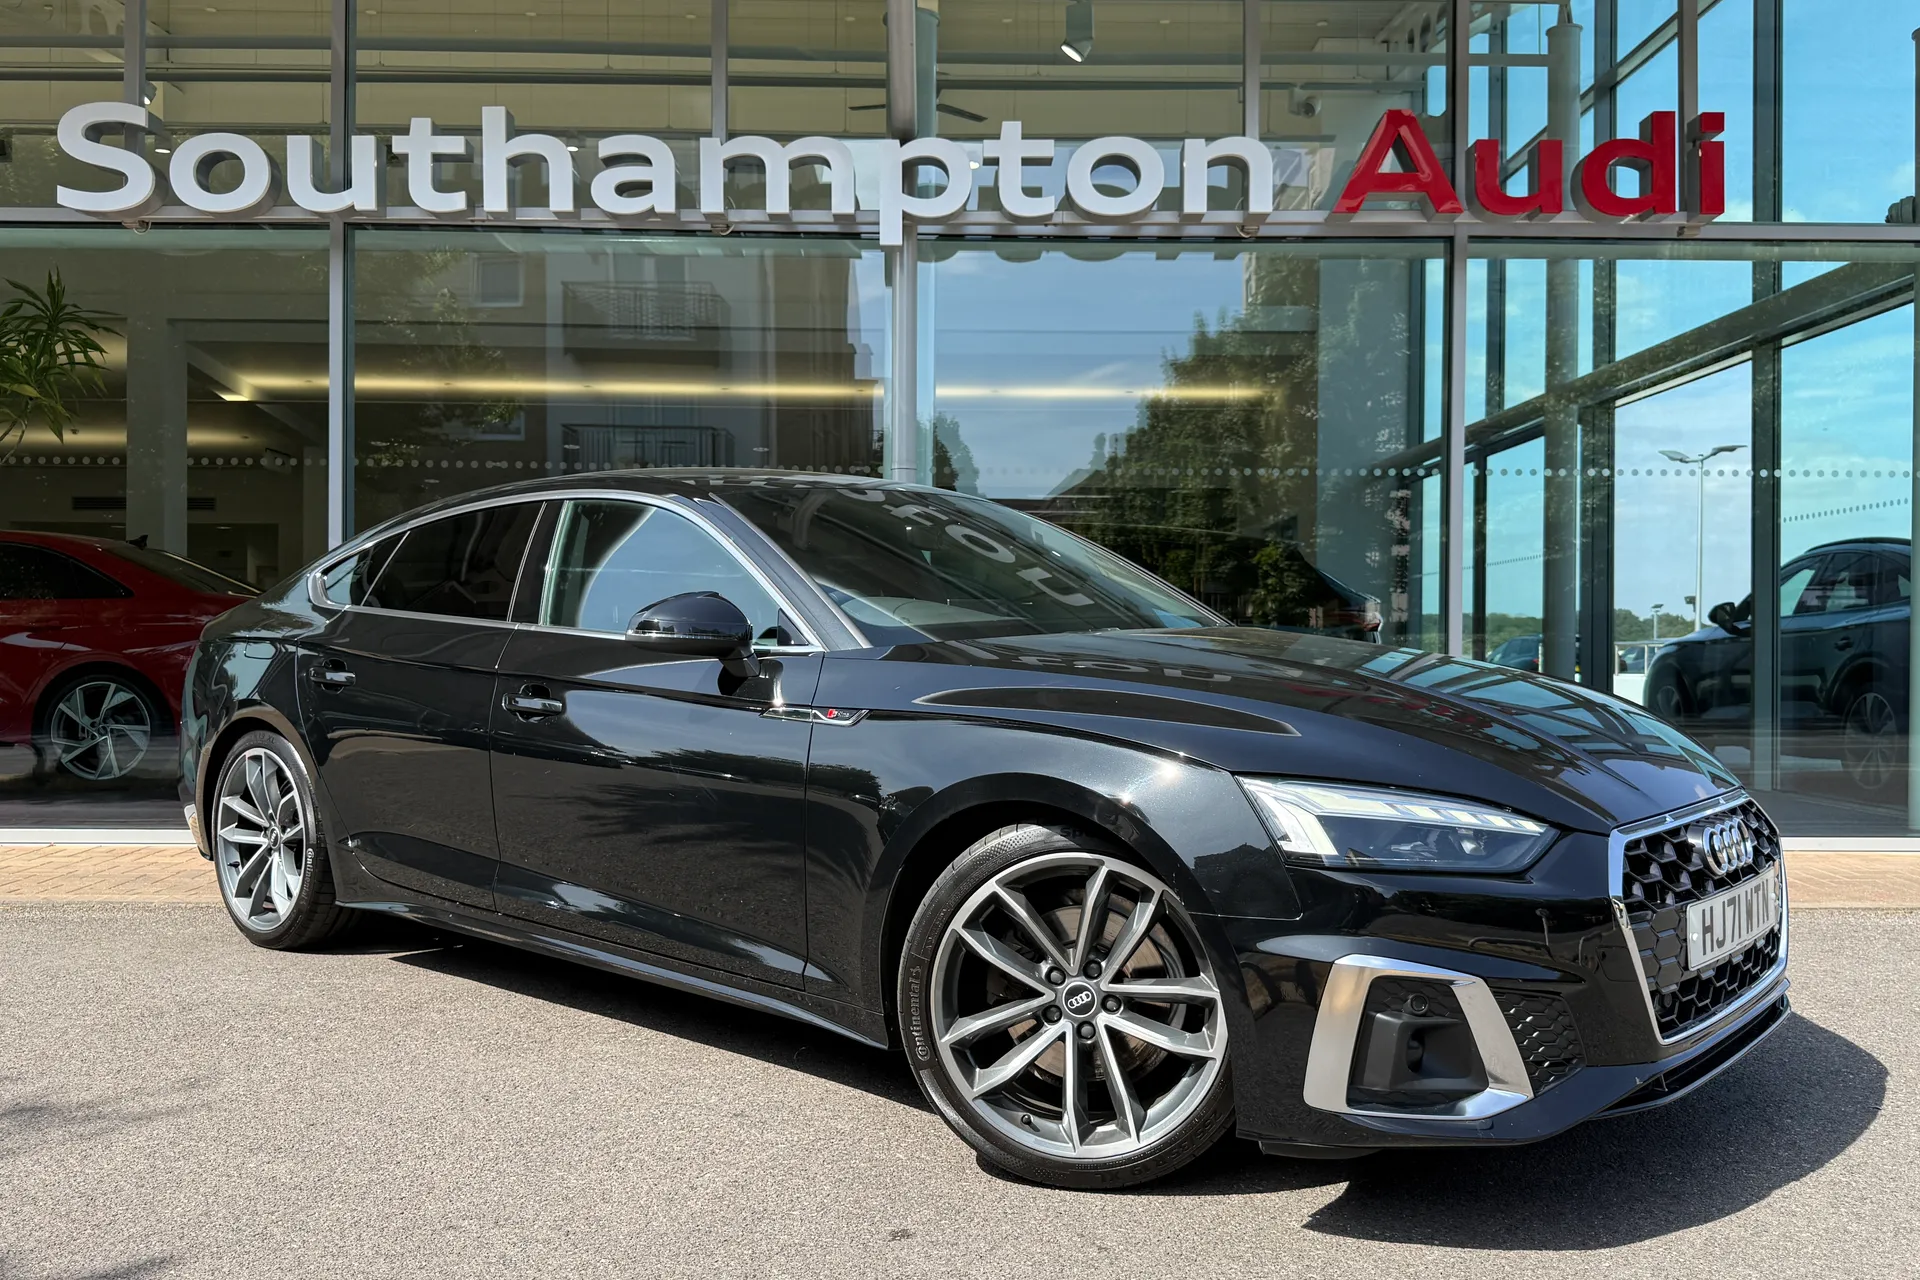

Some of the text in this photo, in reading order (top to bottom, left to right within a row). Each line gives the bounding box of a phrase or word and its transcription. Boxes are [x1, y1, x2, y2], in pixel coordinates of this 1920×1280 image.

[56, 101, 1725, 247] Southampton Audi
[1701, 878, 1770, 956] HJ71 WTN
[909, 977, 931, 1062] Continental
